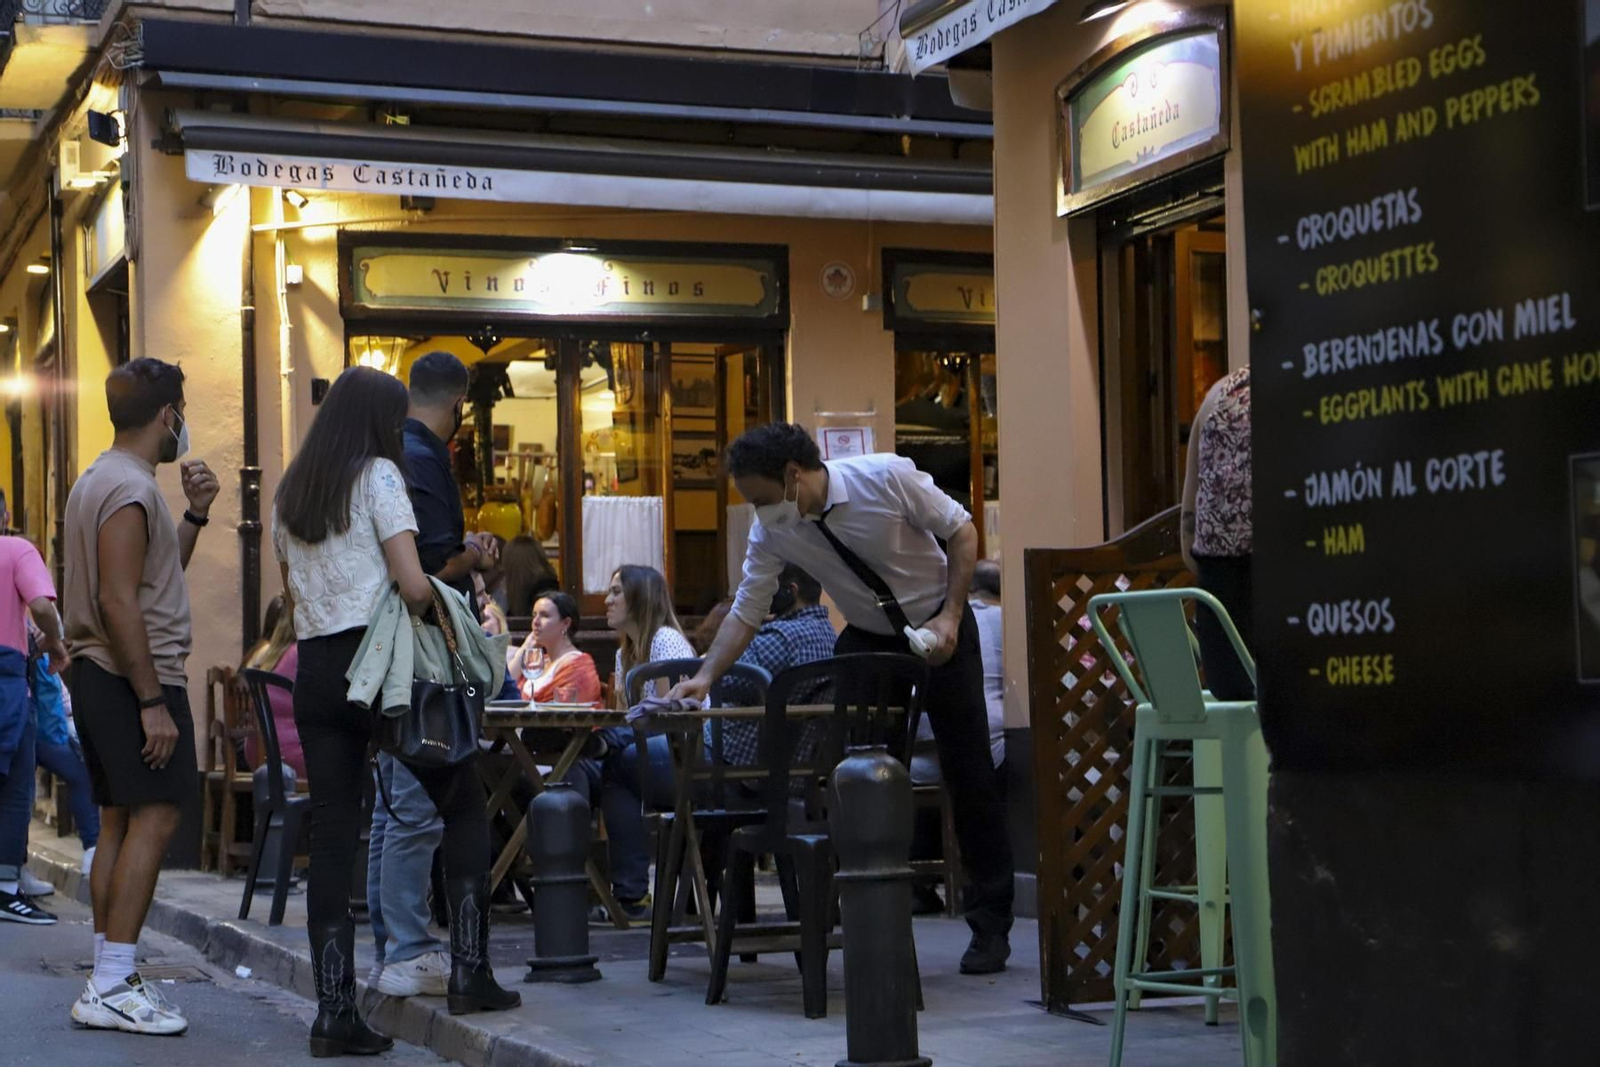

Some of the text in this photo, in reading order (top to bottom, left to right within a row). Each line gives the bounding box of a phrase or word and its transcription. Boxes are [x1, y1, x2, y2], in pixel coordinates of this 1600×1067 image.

[915, 9, 978, 62] Bodegas
[1291, 41, 1303, 71] Y
[1312, 0, 1434, 66] PIMIENTOS
[1308, 34, 1486, 118] SCRAMBLED EGGS
[1111, 99, 1181, 149] Castañeda
[1293, 73, 1540, 174] WITH HAM AND PEPPERS
[212, 153, 493, 191] Bodegas Castañeda
[1297, 187, 1422, 250] CROQUETAS
[432, 267, 550, 295] Vino
[1316, 242, 1439, 296] CROQUETTES
[958, 285, 995, 310] Vi
[1302, 292, 1576, 378] BERENJENAS CON MIEL
[1320, 350, 1600, 425] EGGPLANTS WITH CANE HO
[1305, 449, 1506, 507] JAMÓN AL CORTE
[1324, 523, 1365, 555] HAM
[1307, 598, 1395, 636] QUESOS
[1326, 655, 1395, 685] CHEESE
